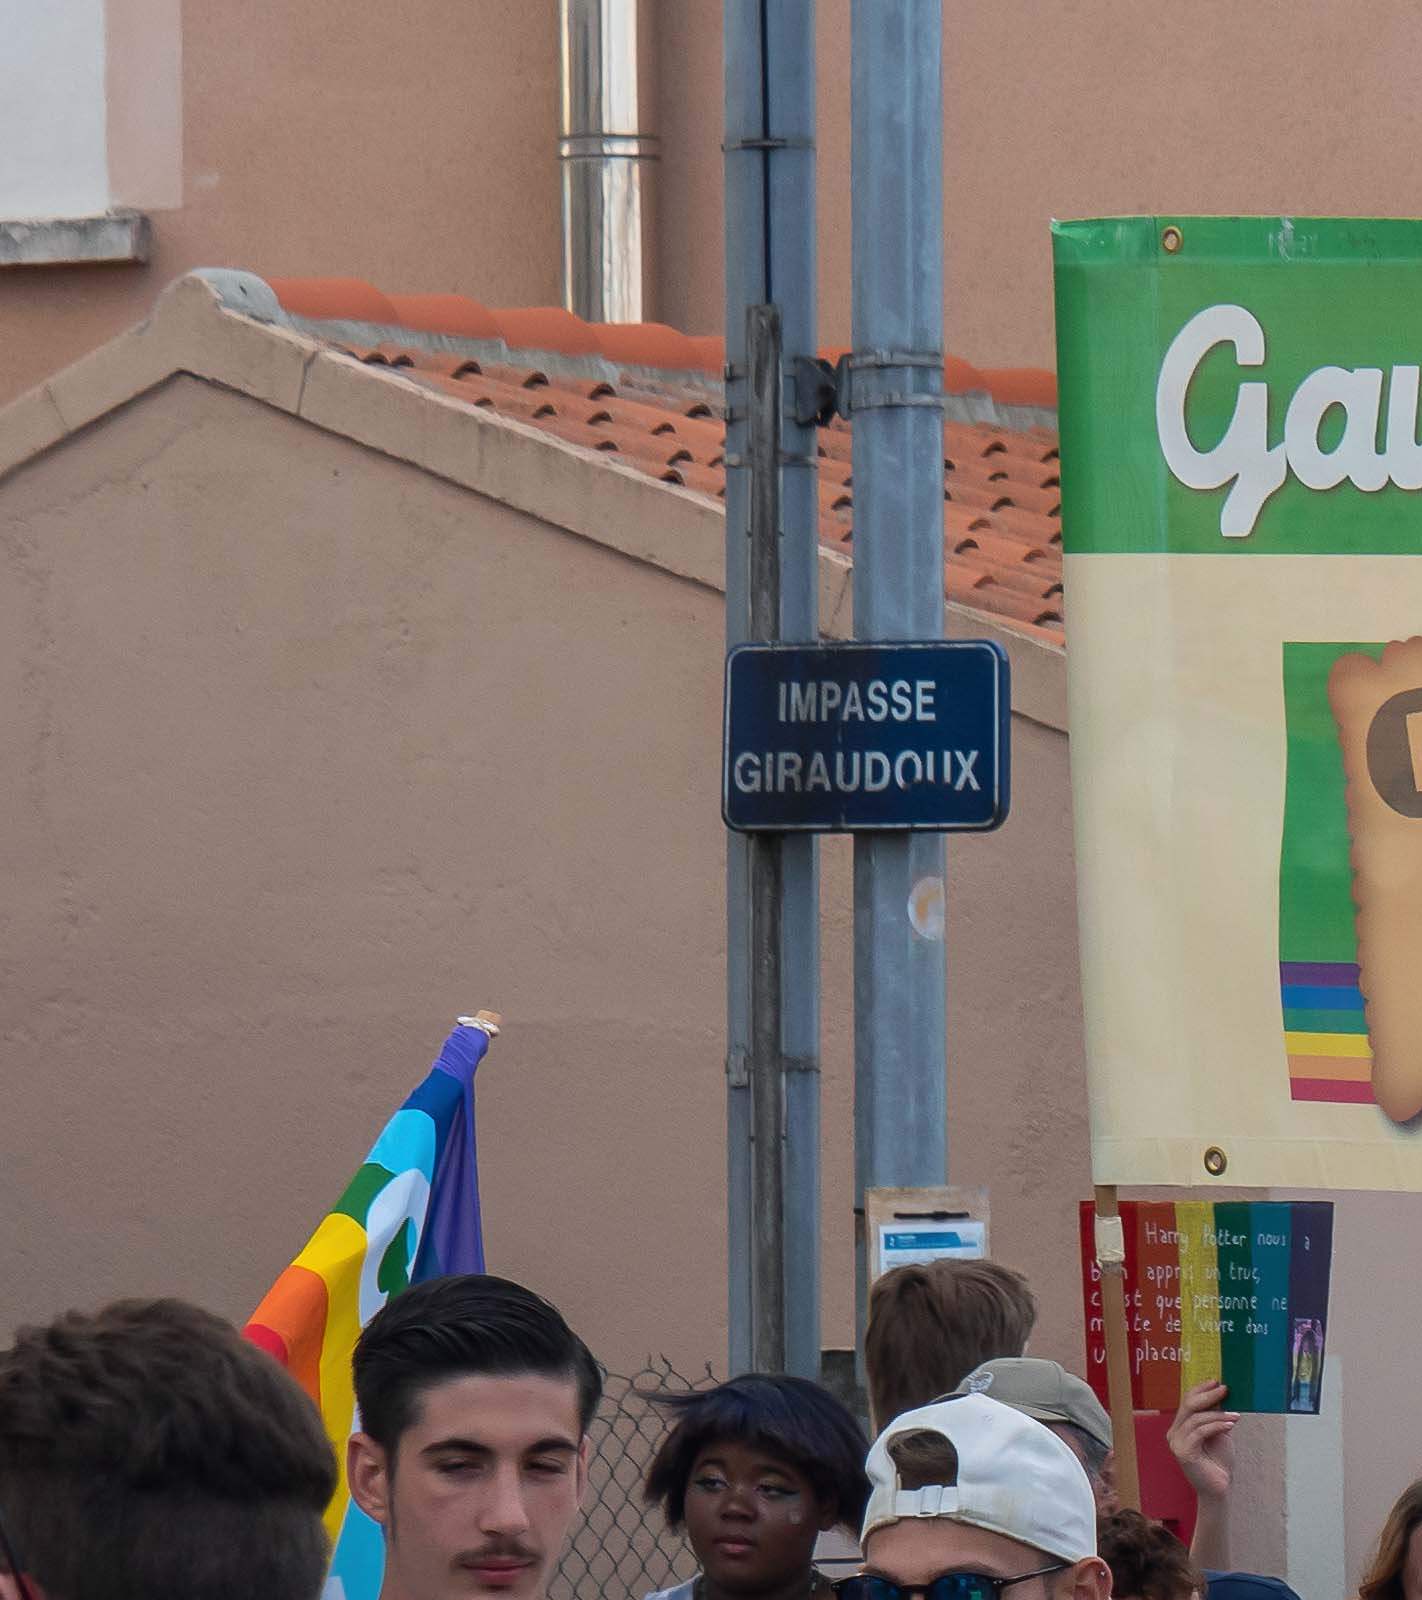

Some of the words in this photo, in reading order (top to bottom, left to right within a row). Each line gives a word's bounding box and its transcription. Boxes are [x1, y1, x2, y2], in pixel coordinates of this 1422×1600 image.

[778, 679, 937, 723] IMPASSE
[733, 750, 982, 794] GIRAUDOUX
[1144, 1222, 1189, 1251] Harry
[1202, 1223, 1247, 1248] Potter
[1257, 1230, 1287, 1247] nous
[1303, 1234, 1311, 1251] a
[1090, 1262, 1127, 1282] bn
[1155, 1294, 1182, 1319] que
[1193, 1294, 1258, 1320] personne
[1271, 1295, 1288, 1311] ne
[1166, 1314, 1181, 1333] de
[1245, 1317, 1269, 1335] dans
[1135, 1339, 1192, 1377] placard
